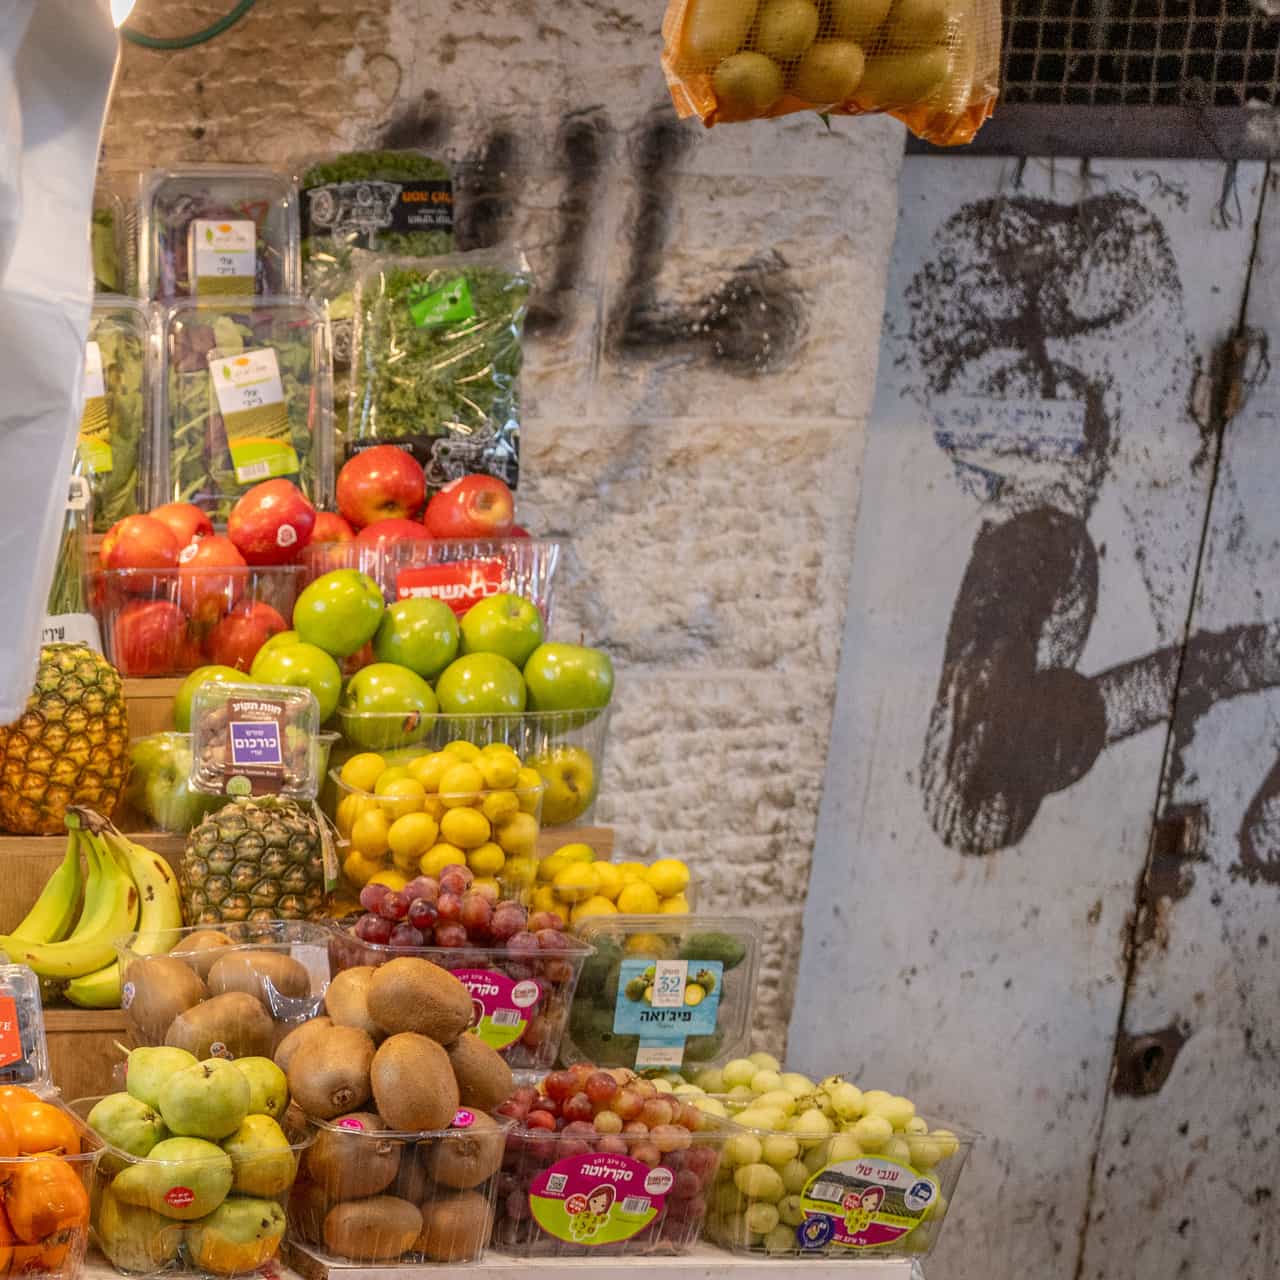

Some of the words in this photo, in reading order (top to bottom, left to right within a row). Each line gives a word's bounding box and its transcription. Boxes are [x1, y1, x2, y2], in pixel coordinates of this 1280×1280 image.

[235, 738, 277, 749] כורכום
[657, 976, 681, 993] 32
[639, 1009, 692, 1023] פיג'ואה
[580, 1163, 634, 1182] סקרלוטה
